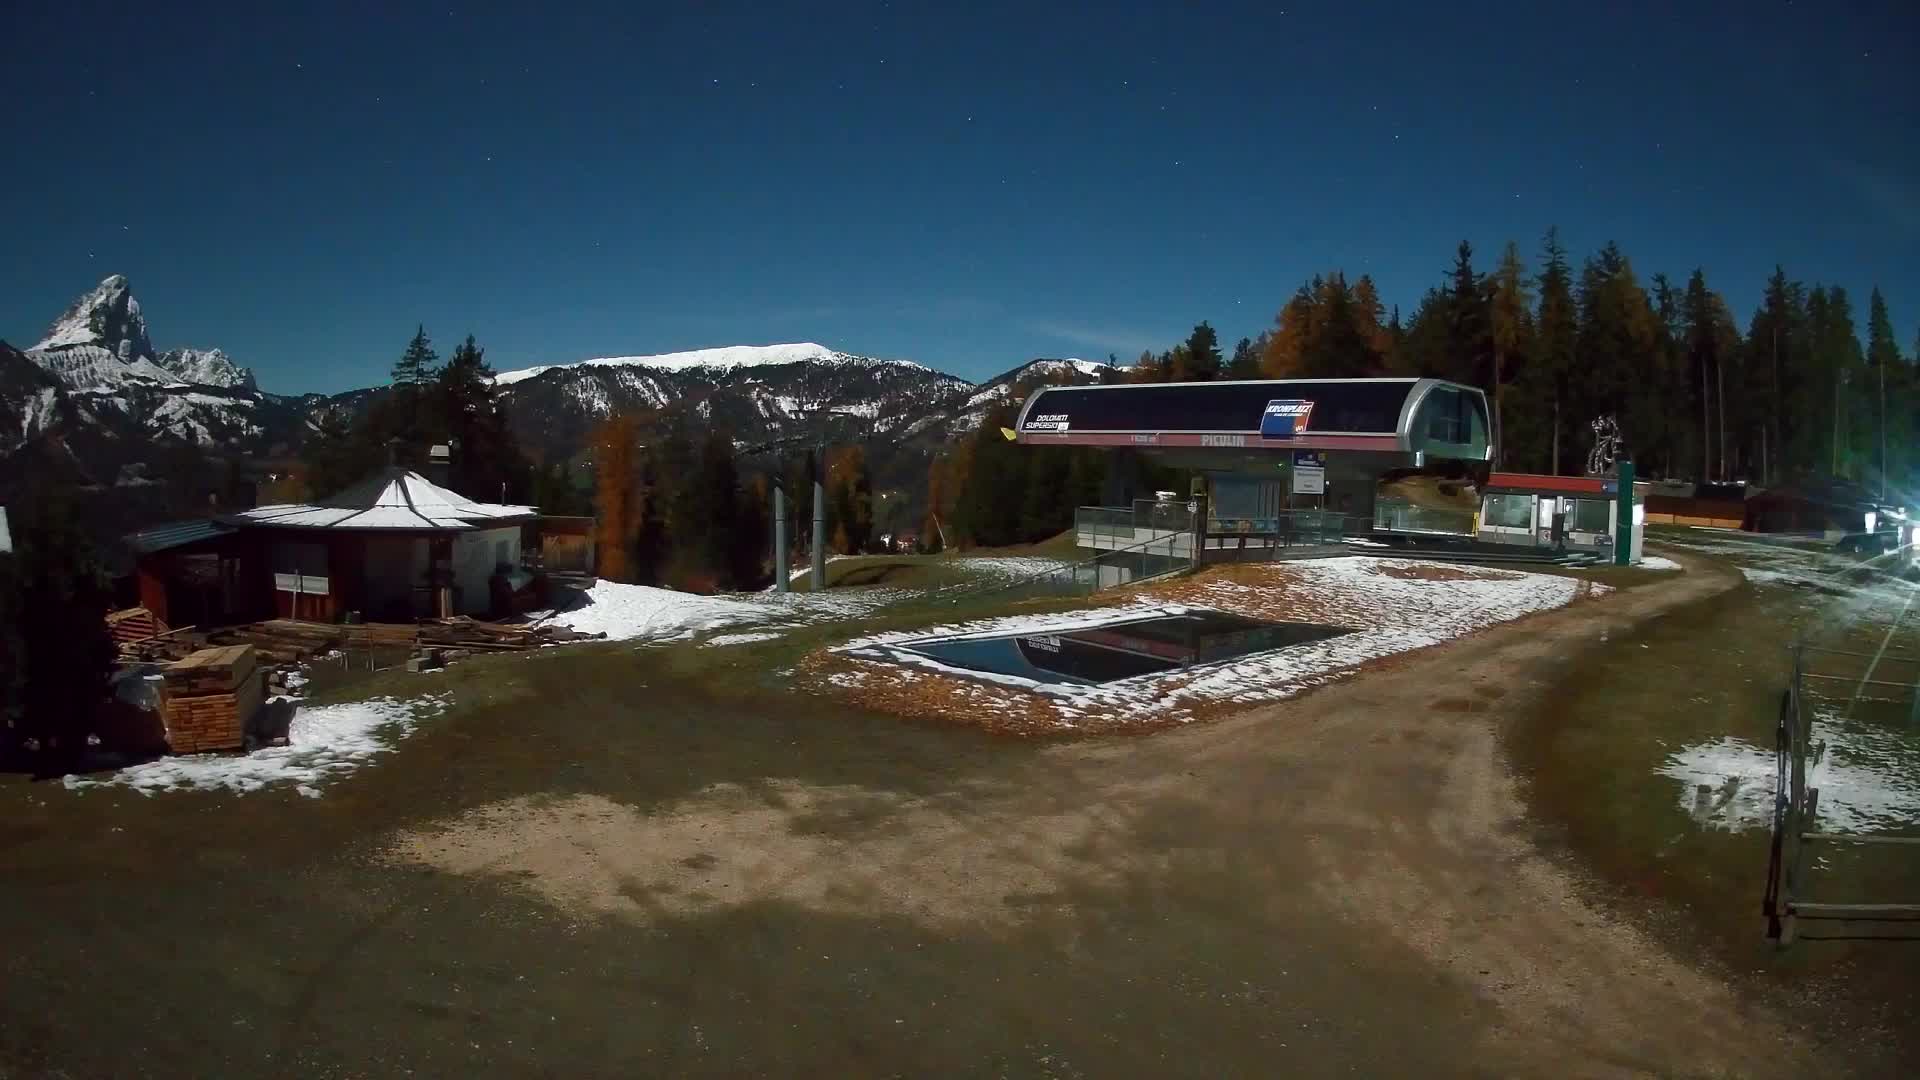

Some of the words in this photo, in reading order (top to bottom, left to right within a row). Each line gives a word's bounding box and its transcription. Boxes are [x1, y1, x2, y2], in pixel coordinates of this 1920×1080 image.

[1266, 405, 1311, 413] KRONPLATZ
[1025, 421, 1058, 429] SUPERSKI
[1201, 434, 1245, 447] PICULIN
